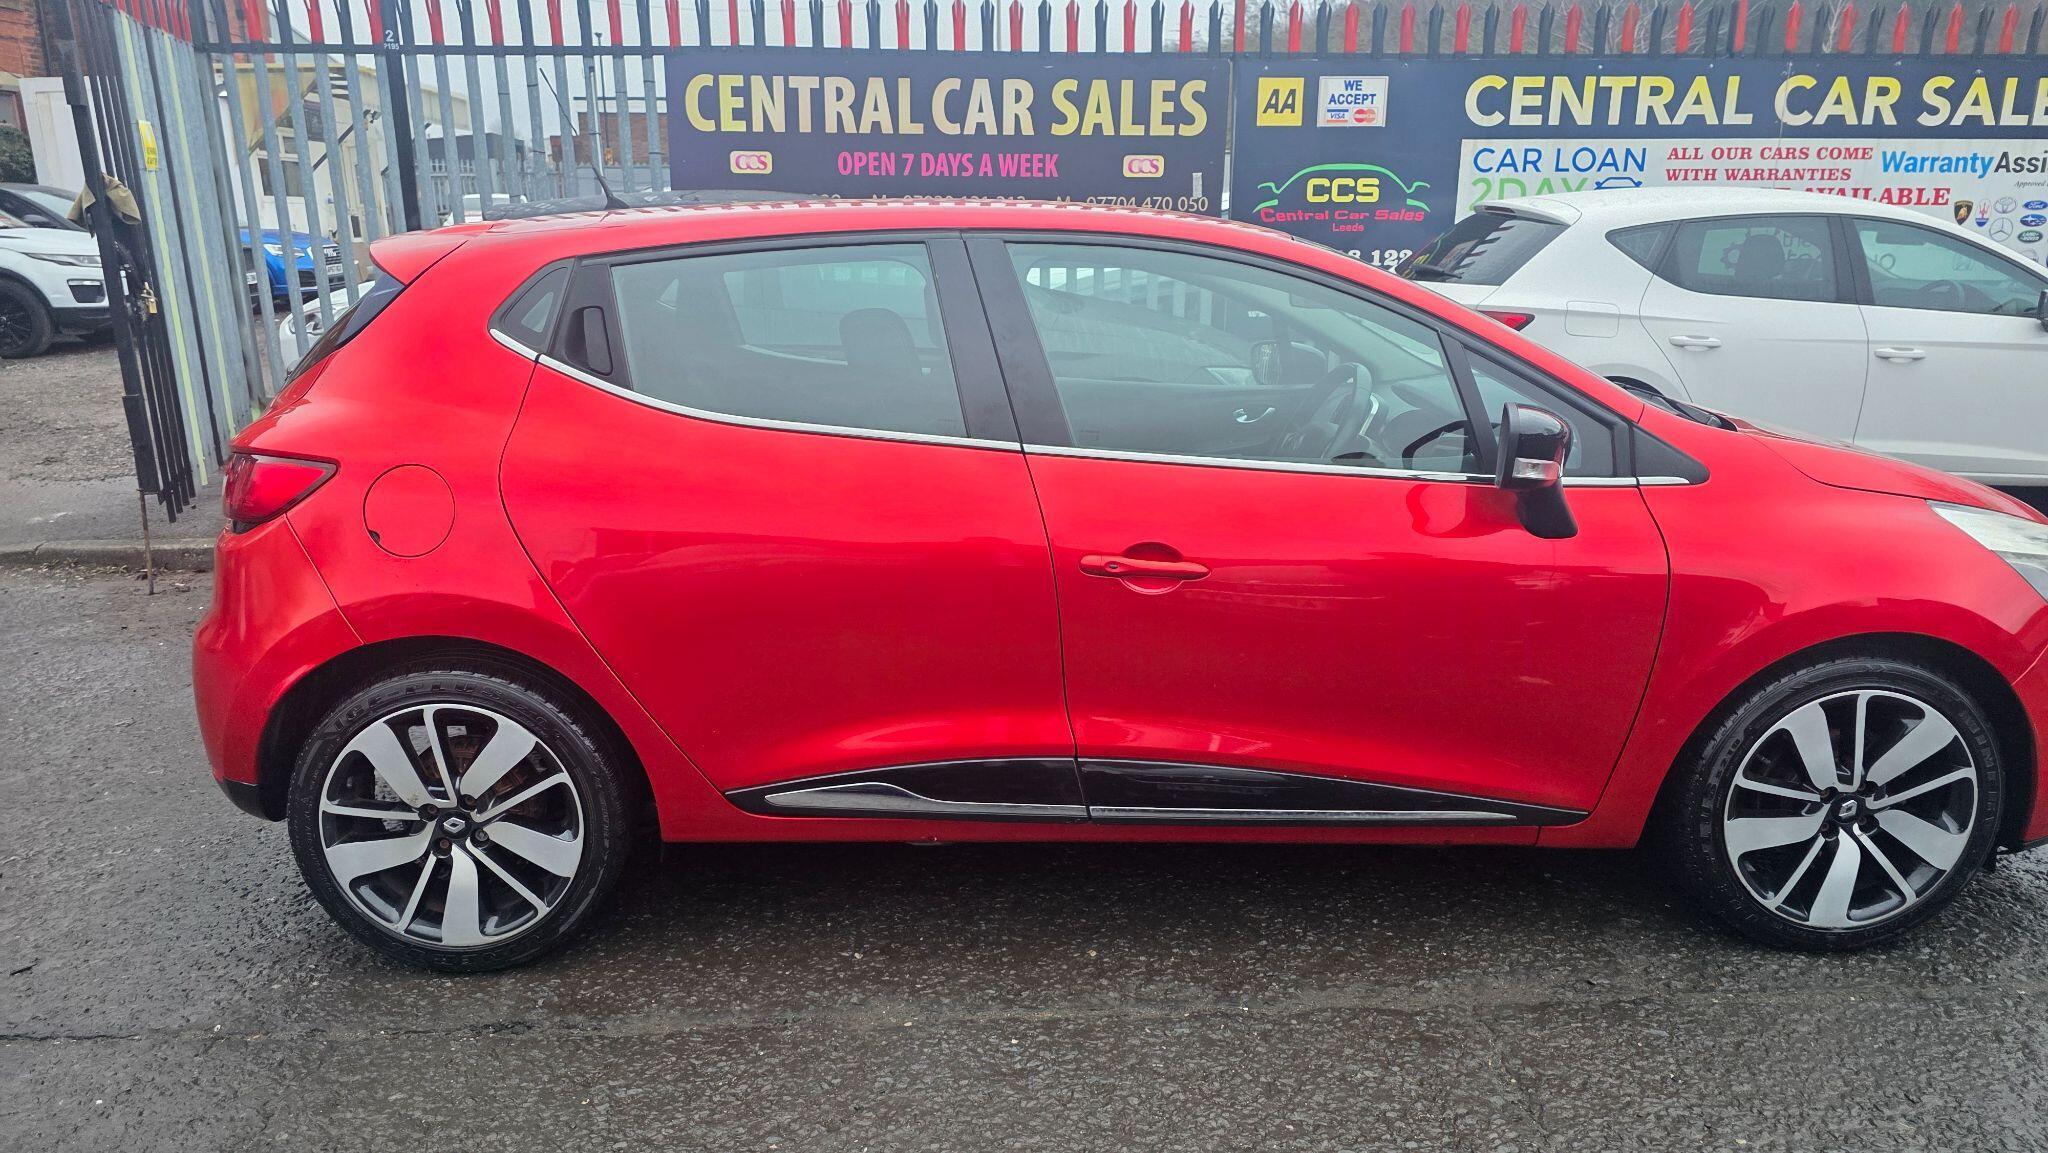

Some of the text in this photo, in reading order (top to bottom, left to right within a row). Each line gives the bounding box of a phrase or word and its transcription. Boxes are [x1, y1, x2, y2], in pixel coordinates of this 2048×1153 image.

[385, 29, 395, 42] 2
[1344, 80, 1362, 91] WE
[685, 73, 1208, 137] CENTRAL CAR SALES
[1262, 88, 1297, 114] AA
[1328, 93, 1377, 105] ACCEPT
[1465, 74, 1753, 127] CENTRAL
[1774, 74, 1901, 127] CAR
[1473, 146, 1647, 173] CAR LOAN
[1667, 147, 1874, 160] ALL OUR CARS COME
[837, 151, 1060, 178] OPEN 7 DAYS A WEEK
[1665, 168, 1852, 181] WITH WARRANTIES
[1306, 177, 1380, 203] CCS
[1177, 196, 1209, 212] 050
[1260, 208, 1425, 223] Central Car Sales
[1332, 223, 1364, 232] Leeds
